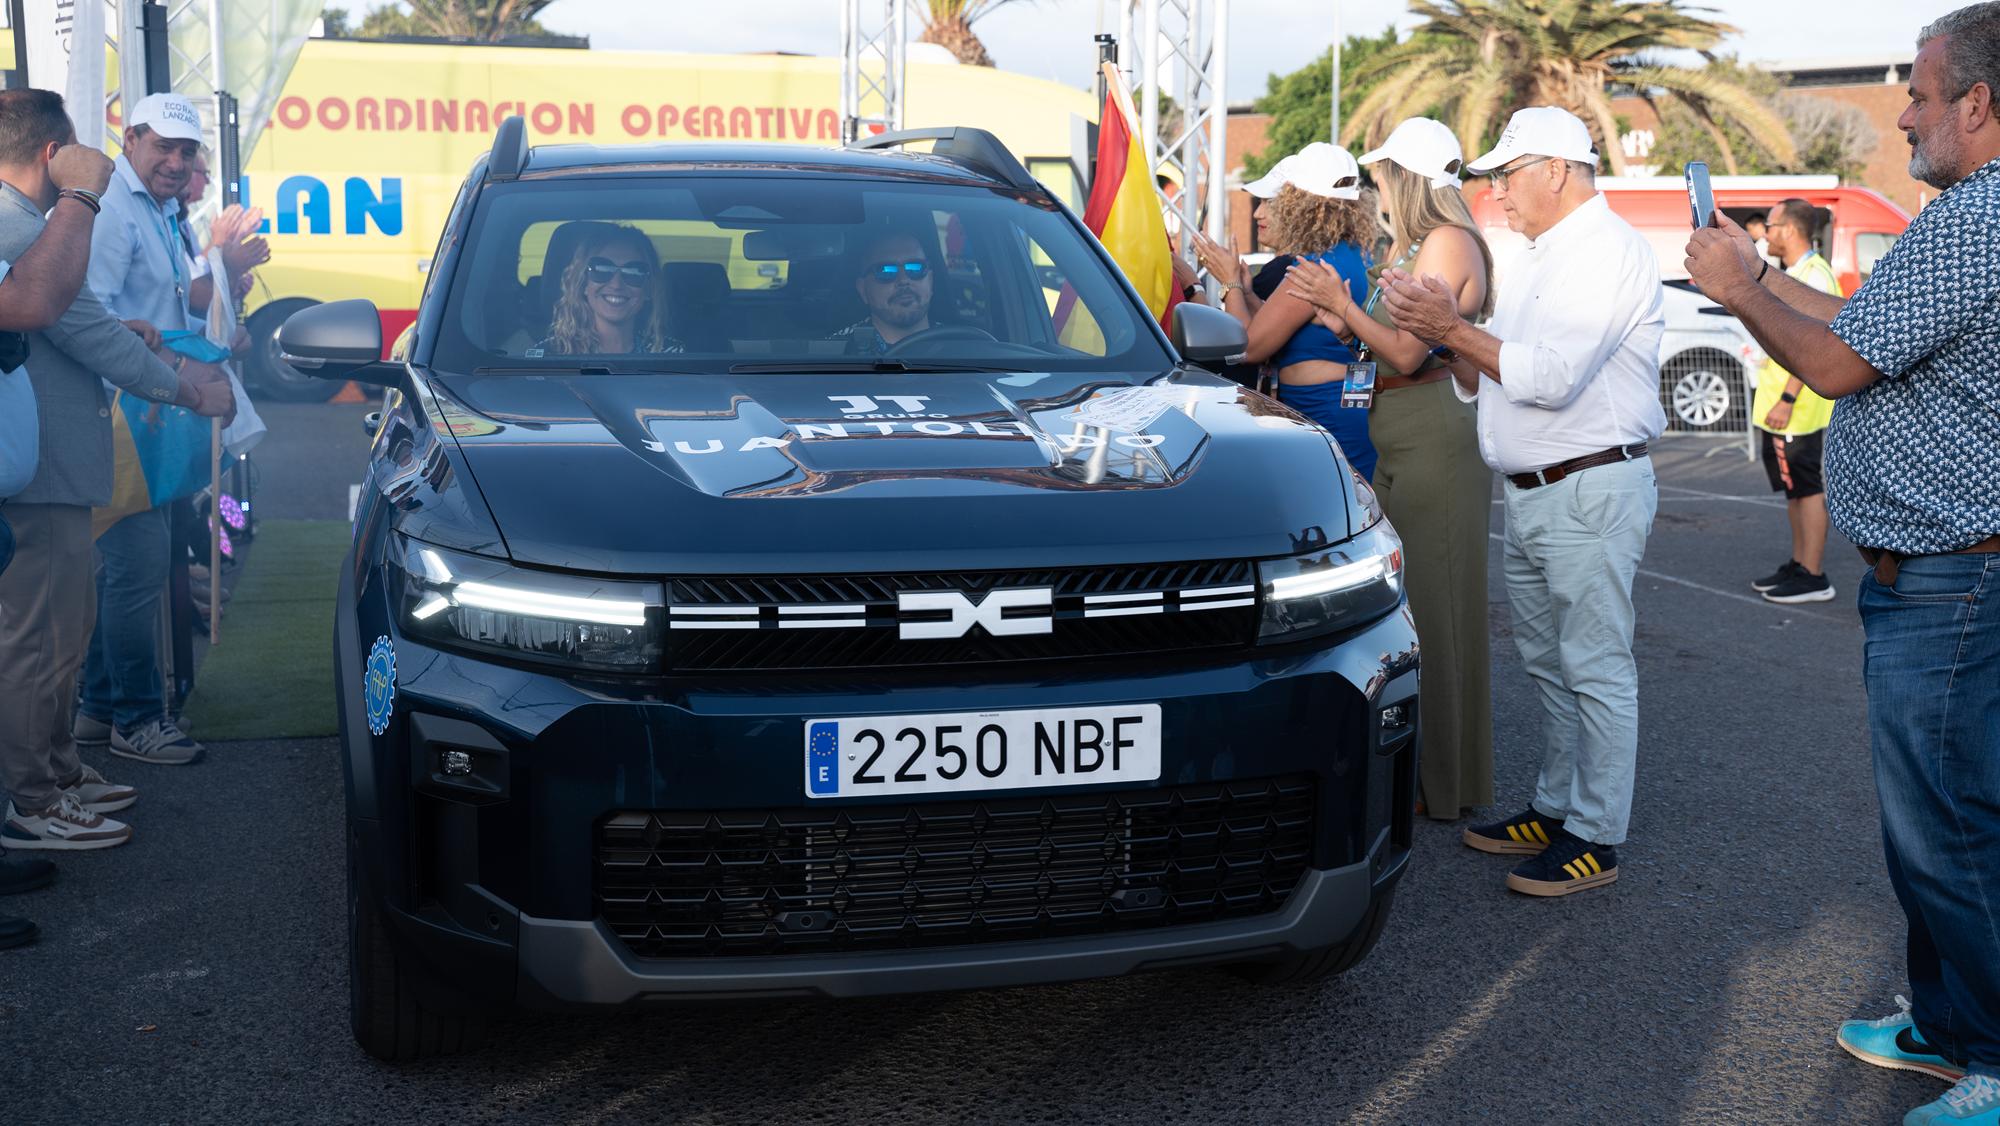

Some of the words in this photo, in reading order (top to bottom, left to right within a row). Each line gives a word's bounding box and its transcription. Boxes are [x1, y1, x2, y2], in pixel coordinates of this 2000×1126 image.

[265, 96, 595, 136] OORDINACON
[621, 103, 839, 140] OPERATIVA
[827, 395, 931, 414] JT
[852, 723, 1008, 784] 2250
[1034, 715, 1143, 776] NBF
[819, 766, 830, 782] E
